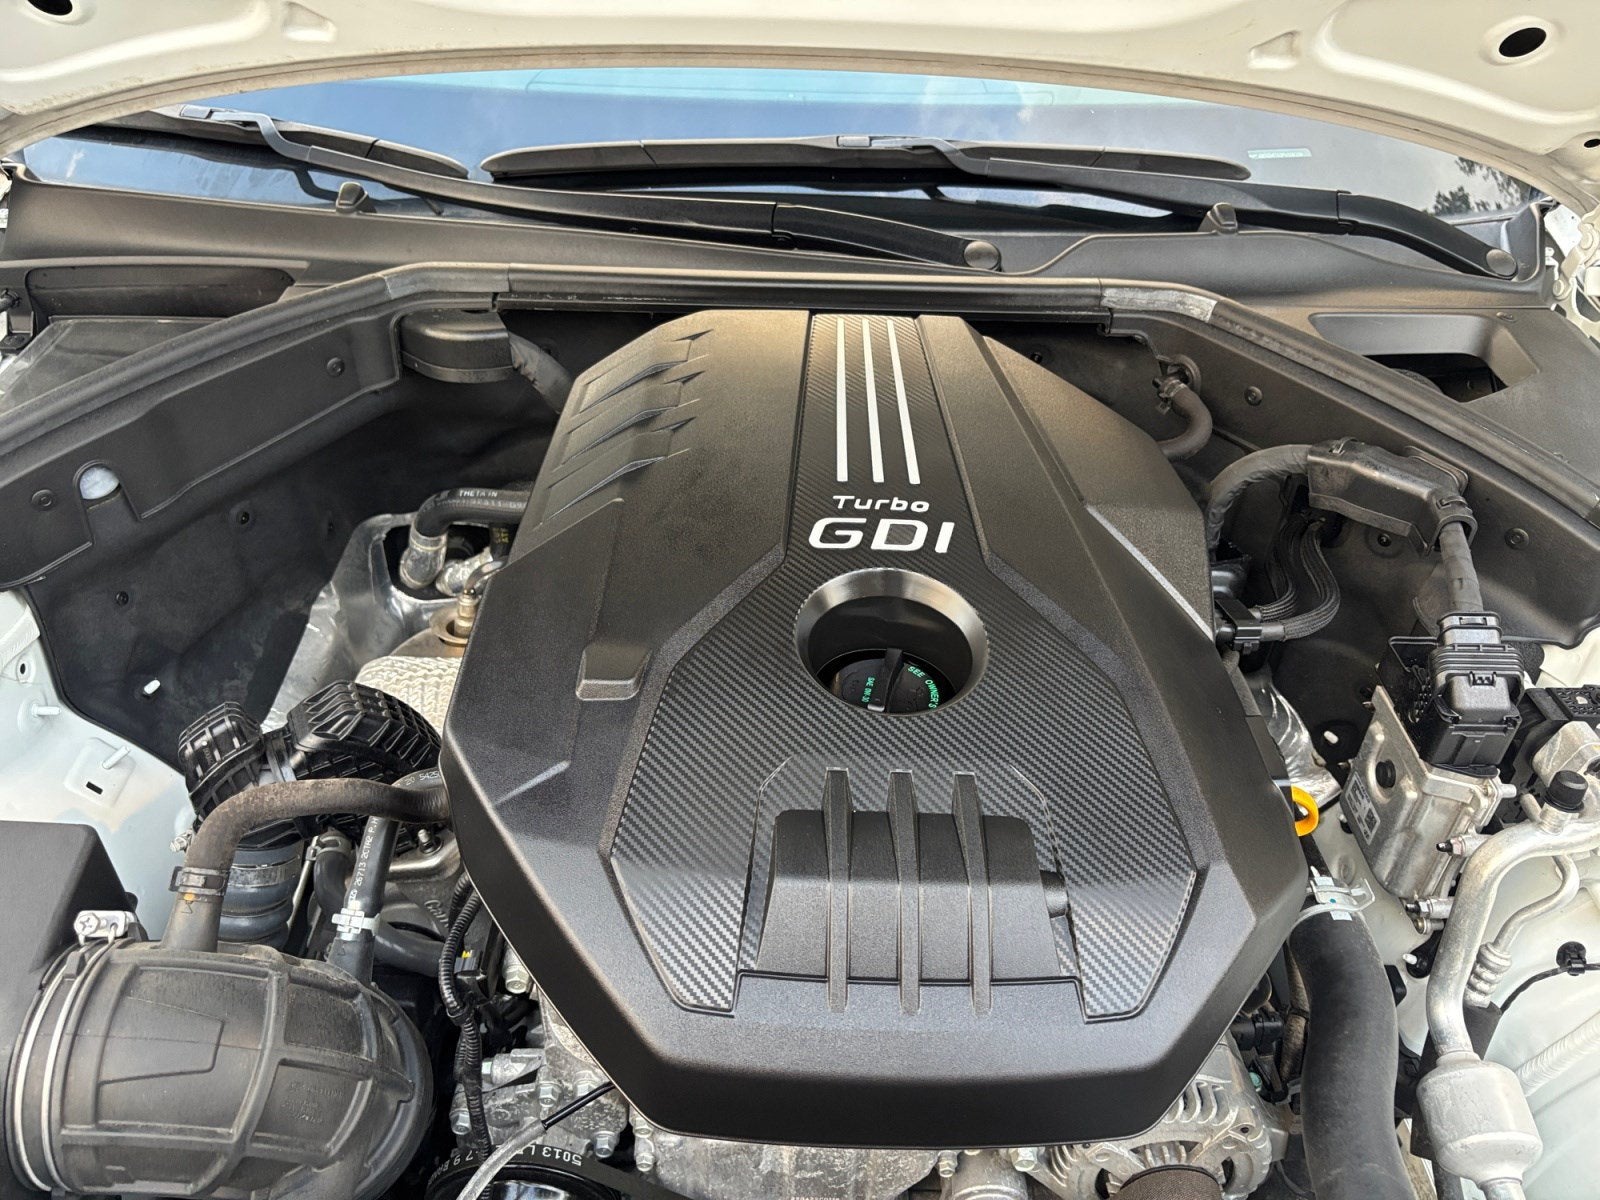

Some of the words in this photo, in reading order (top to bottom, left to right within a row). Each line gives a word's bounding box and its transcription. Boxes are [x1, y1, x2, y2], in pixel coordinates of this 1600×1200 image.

[832, 495, 930, 513] Turbo
[808, 517, 955, 554] GDI
[907, 666, 926, 678] SEE
[924, 679, 940, 709] OWNER'S
[541, 1146, 583, 1167] 5013
